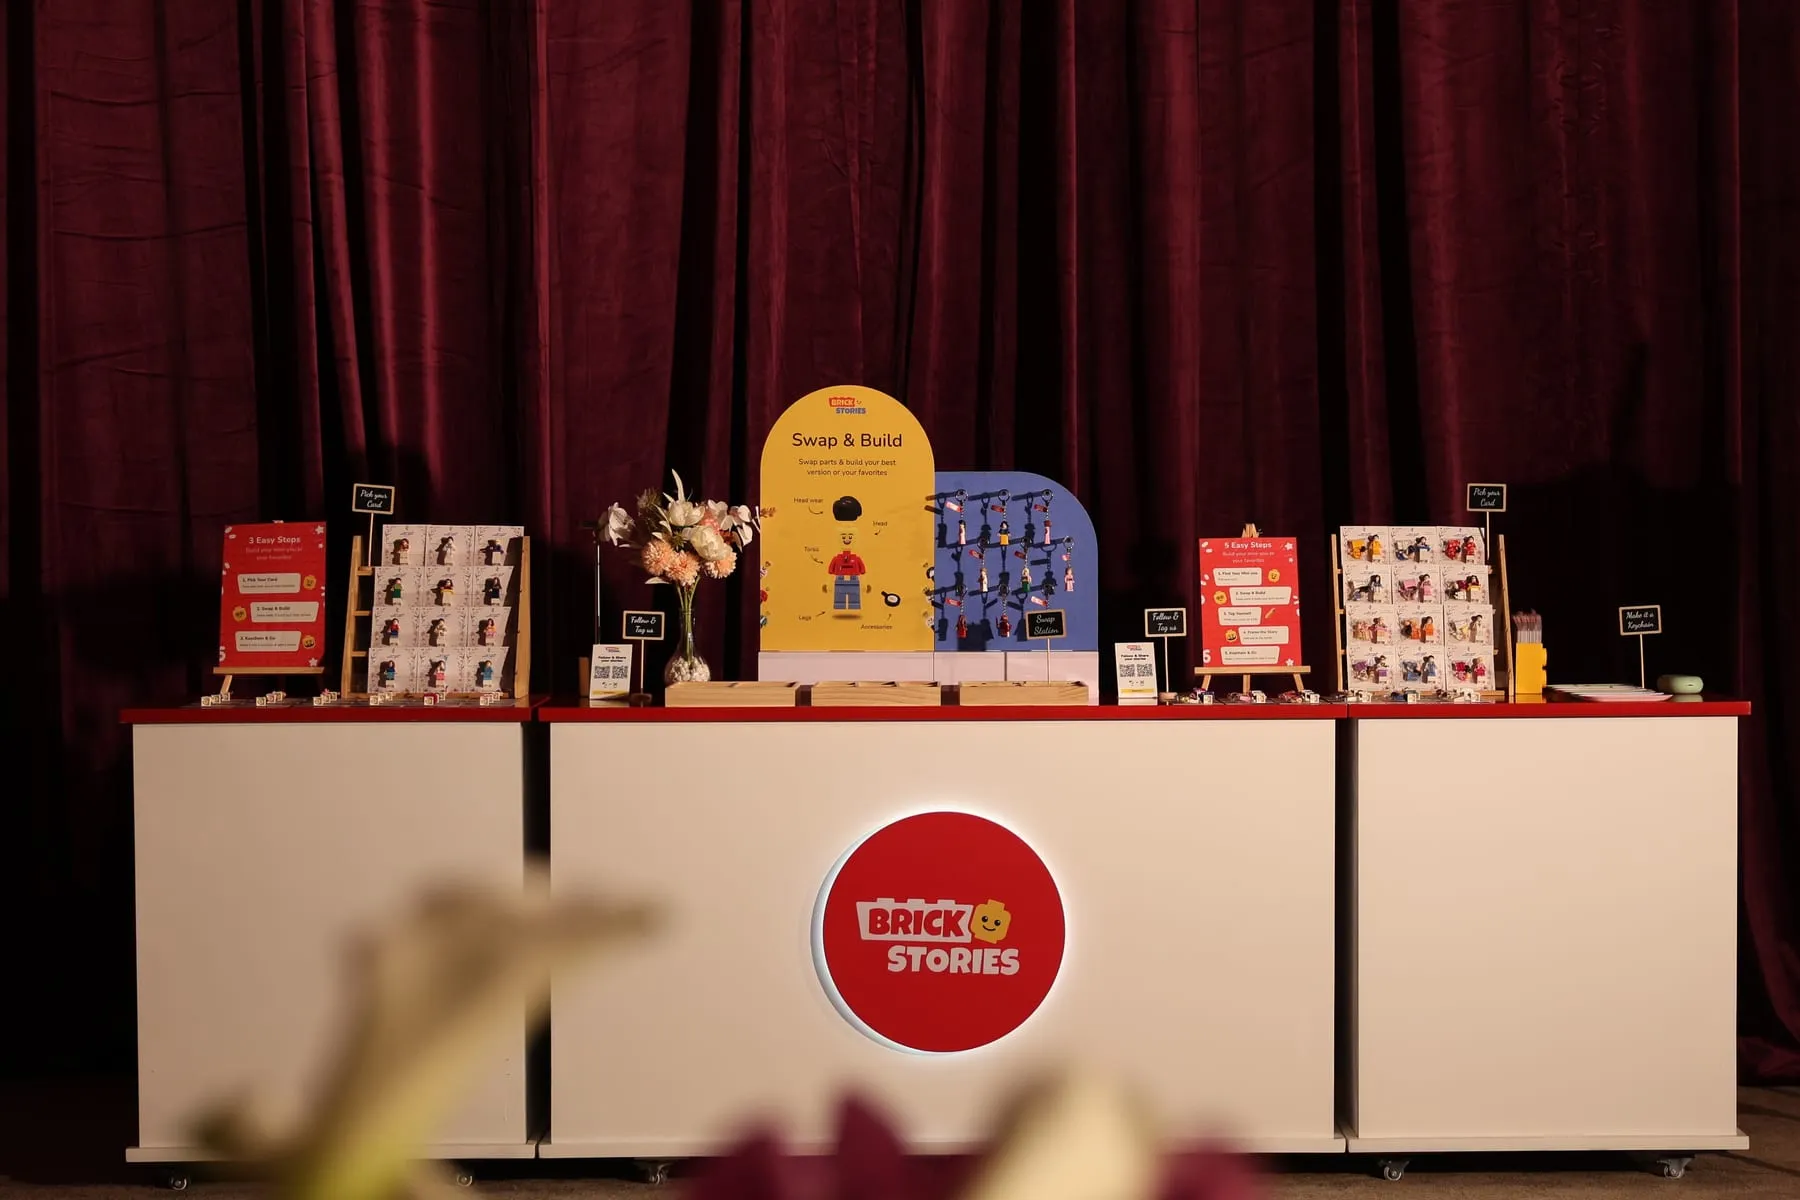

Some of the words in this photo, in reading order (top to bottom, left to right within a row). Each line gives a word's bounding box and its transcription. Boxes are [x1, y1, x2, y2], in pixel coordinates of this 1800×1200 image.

[792, 432, 838, 450] Swap
[844, 433, 854, 447] &
[861, 434, 902, 447] Build
[360, 489, 373, 497] Pick
[1474, 488, 1486, 496] Pick
[1481, 499, 1495, 507] Card
[256, 536, 276, 545] Easy
[277, 536, 301, 544] Steps
[631, 616, 649, 624] Follow
[1036, 614, 1055, 624] Swap
[1153, 612, 1171, 621] Follow
[1173, 612, 1179, 620] &
[1158, 623, 1168, 632] Tag
[1628, 620, 1654, 630] Keychain
[635, 626, 645, 634] Tag
[1034, 626, 1059, 635] Station
[868, 908, 966, 938] BRICK
[887, 944, 1020, 976] STORIES
